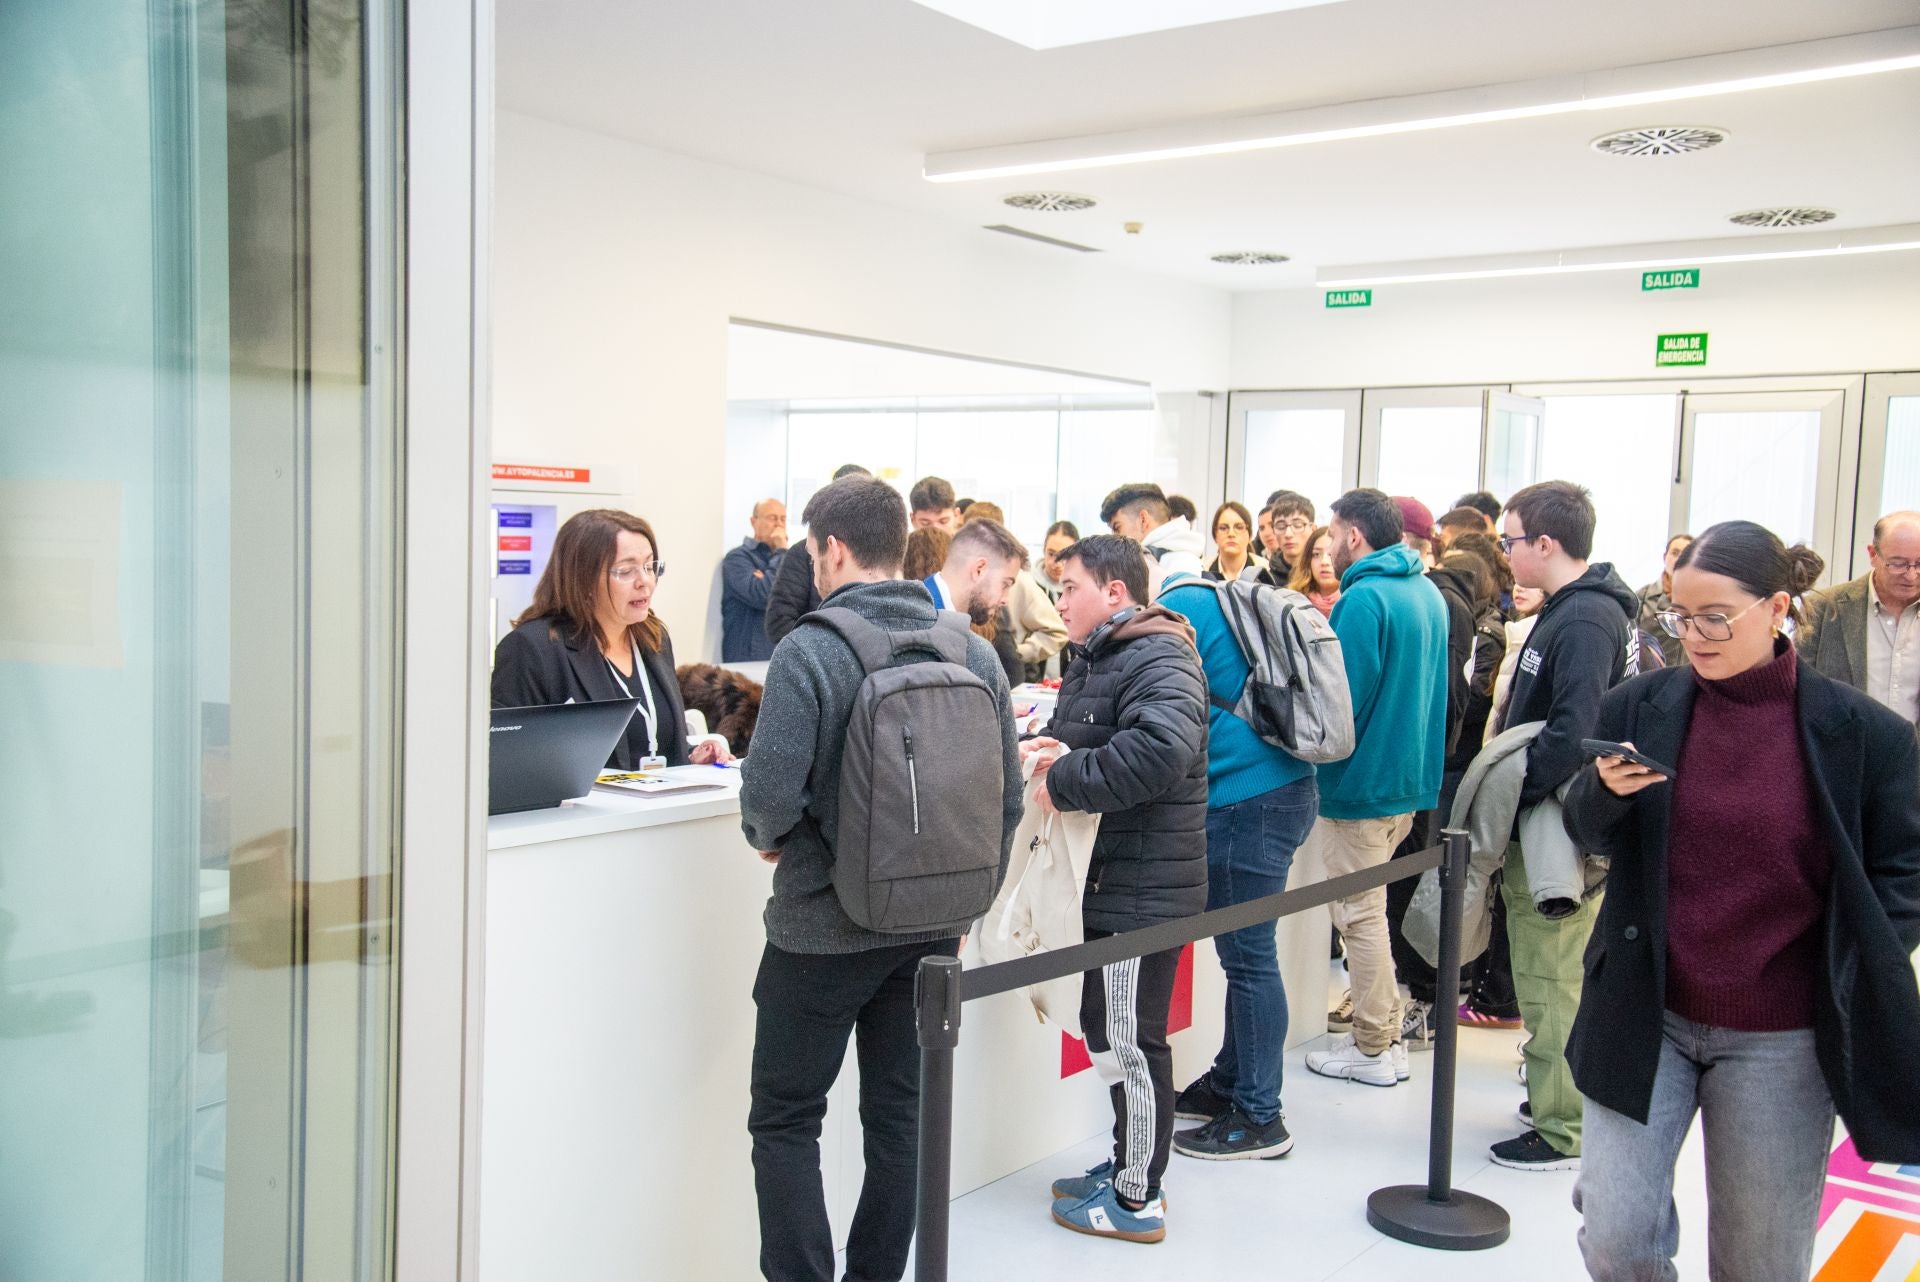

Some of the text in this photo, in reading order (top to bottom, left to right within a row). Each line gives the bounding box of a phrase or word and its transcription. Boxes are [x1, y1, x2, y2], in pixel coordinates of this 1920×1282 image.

[1644, 271, 1693, 288] SALIDA
[1328, 291, 1367, 306] SALIDA
[1663, 336, 1701, 350] SALIDA DE
[1658, 350, 1704, 363] EMERGENCIA
